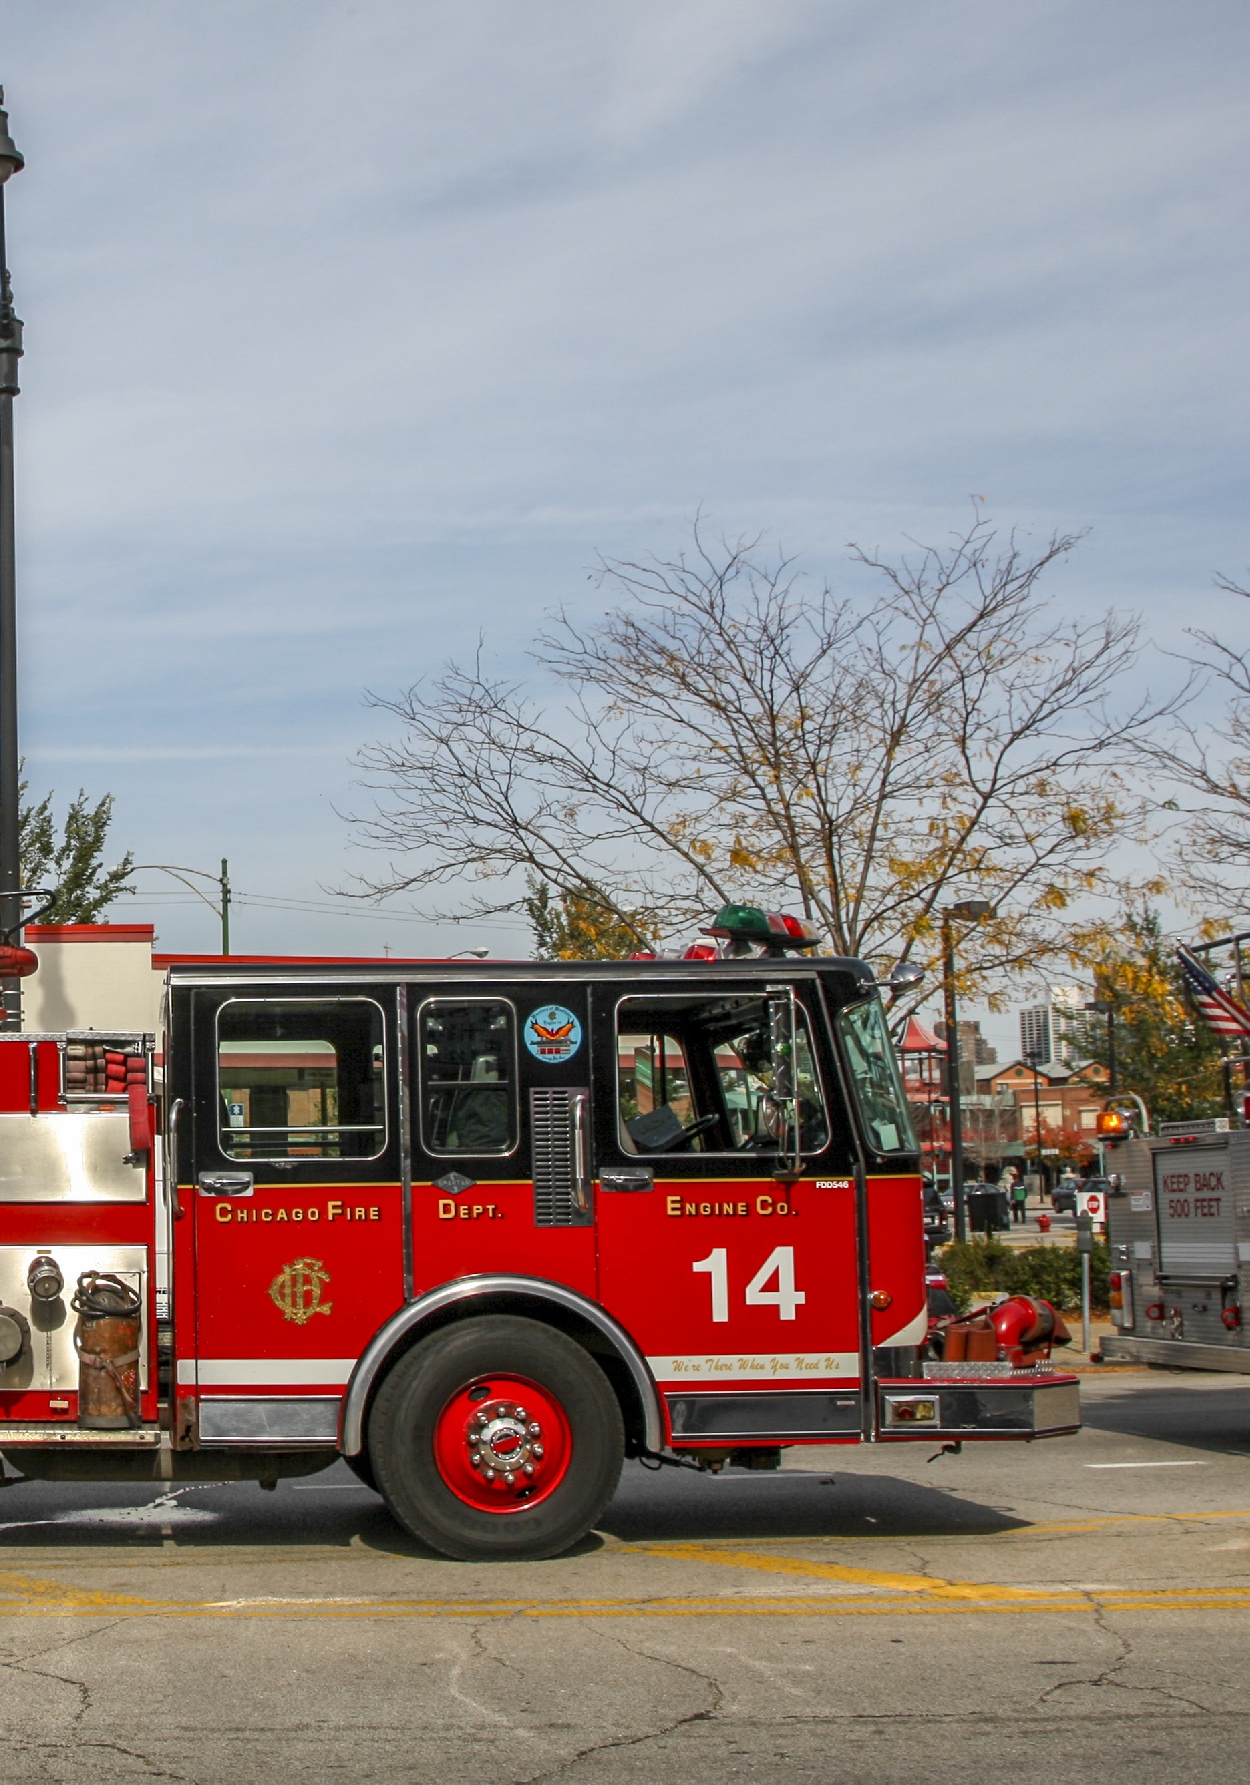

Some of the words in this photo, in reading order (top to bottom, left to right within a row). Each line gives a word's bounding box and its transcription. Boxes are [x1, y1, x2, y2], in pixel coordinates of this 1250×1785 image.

[1163, 1173, 1190, 1193] KEEP
[1195, 1172, 1225, 1192] BACK
[1169, 1200, 1190, 1218] 500
[1195, 1198, 1221, 1217] FEET
[692, 1246, 806, 1323] 14
[672, 1359, 701, 1372] We're
[705, 1358, 733, 1371] There
[738, 1357, 766, 1371] When
[770, 1357, 790, 1375] You
[794, 1356, 820, 1371] Need
[824, 1356, 840, 1370] Us
